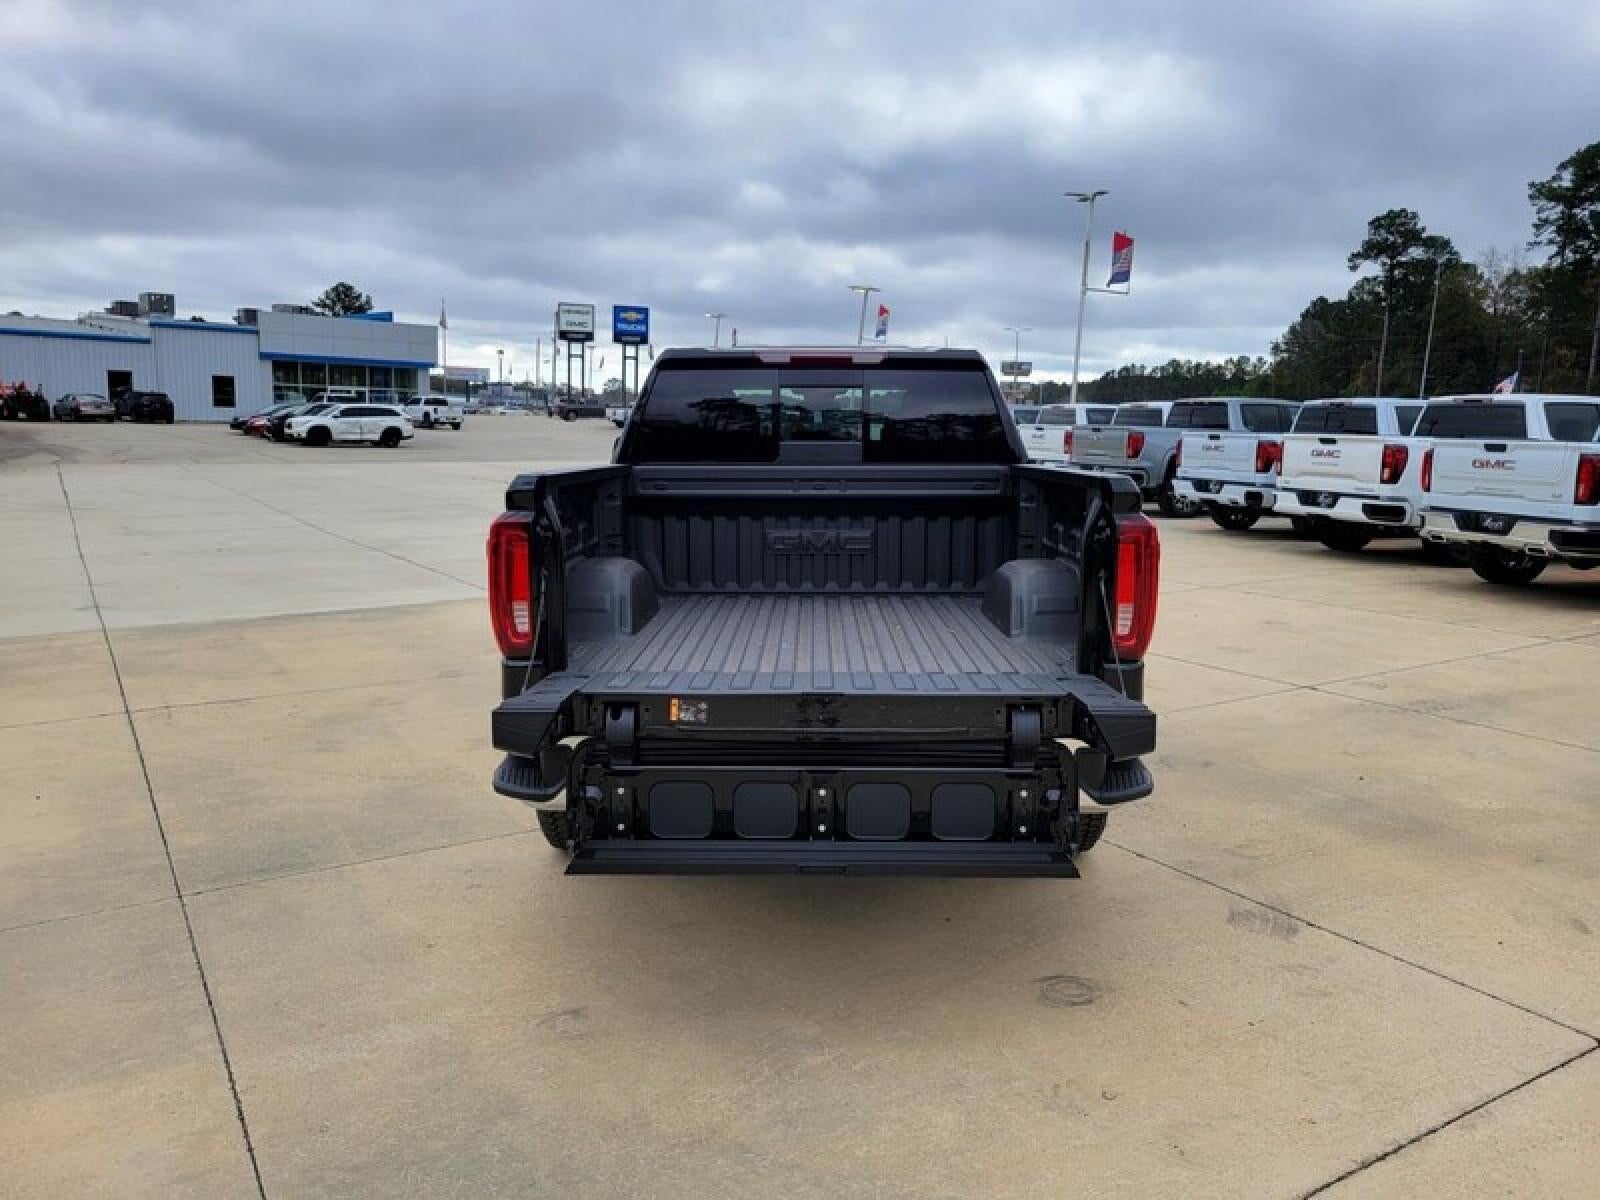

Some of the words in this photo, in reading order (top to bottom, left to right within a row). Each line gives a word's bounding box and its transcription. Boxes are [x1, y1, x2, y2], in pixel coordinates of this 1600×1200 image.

[566, 320, 588, 328] GMC
[1201, 445, 1225, 453] GMC
[1311, 450, 1342, 458] GMC
[1472, 459, 1516, 470] GMC
[766, 529, 874, 552] GMC
